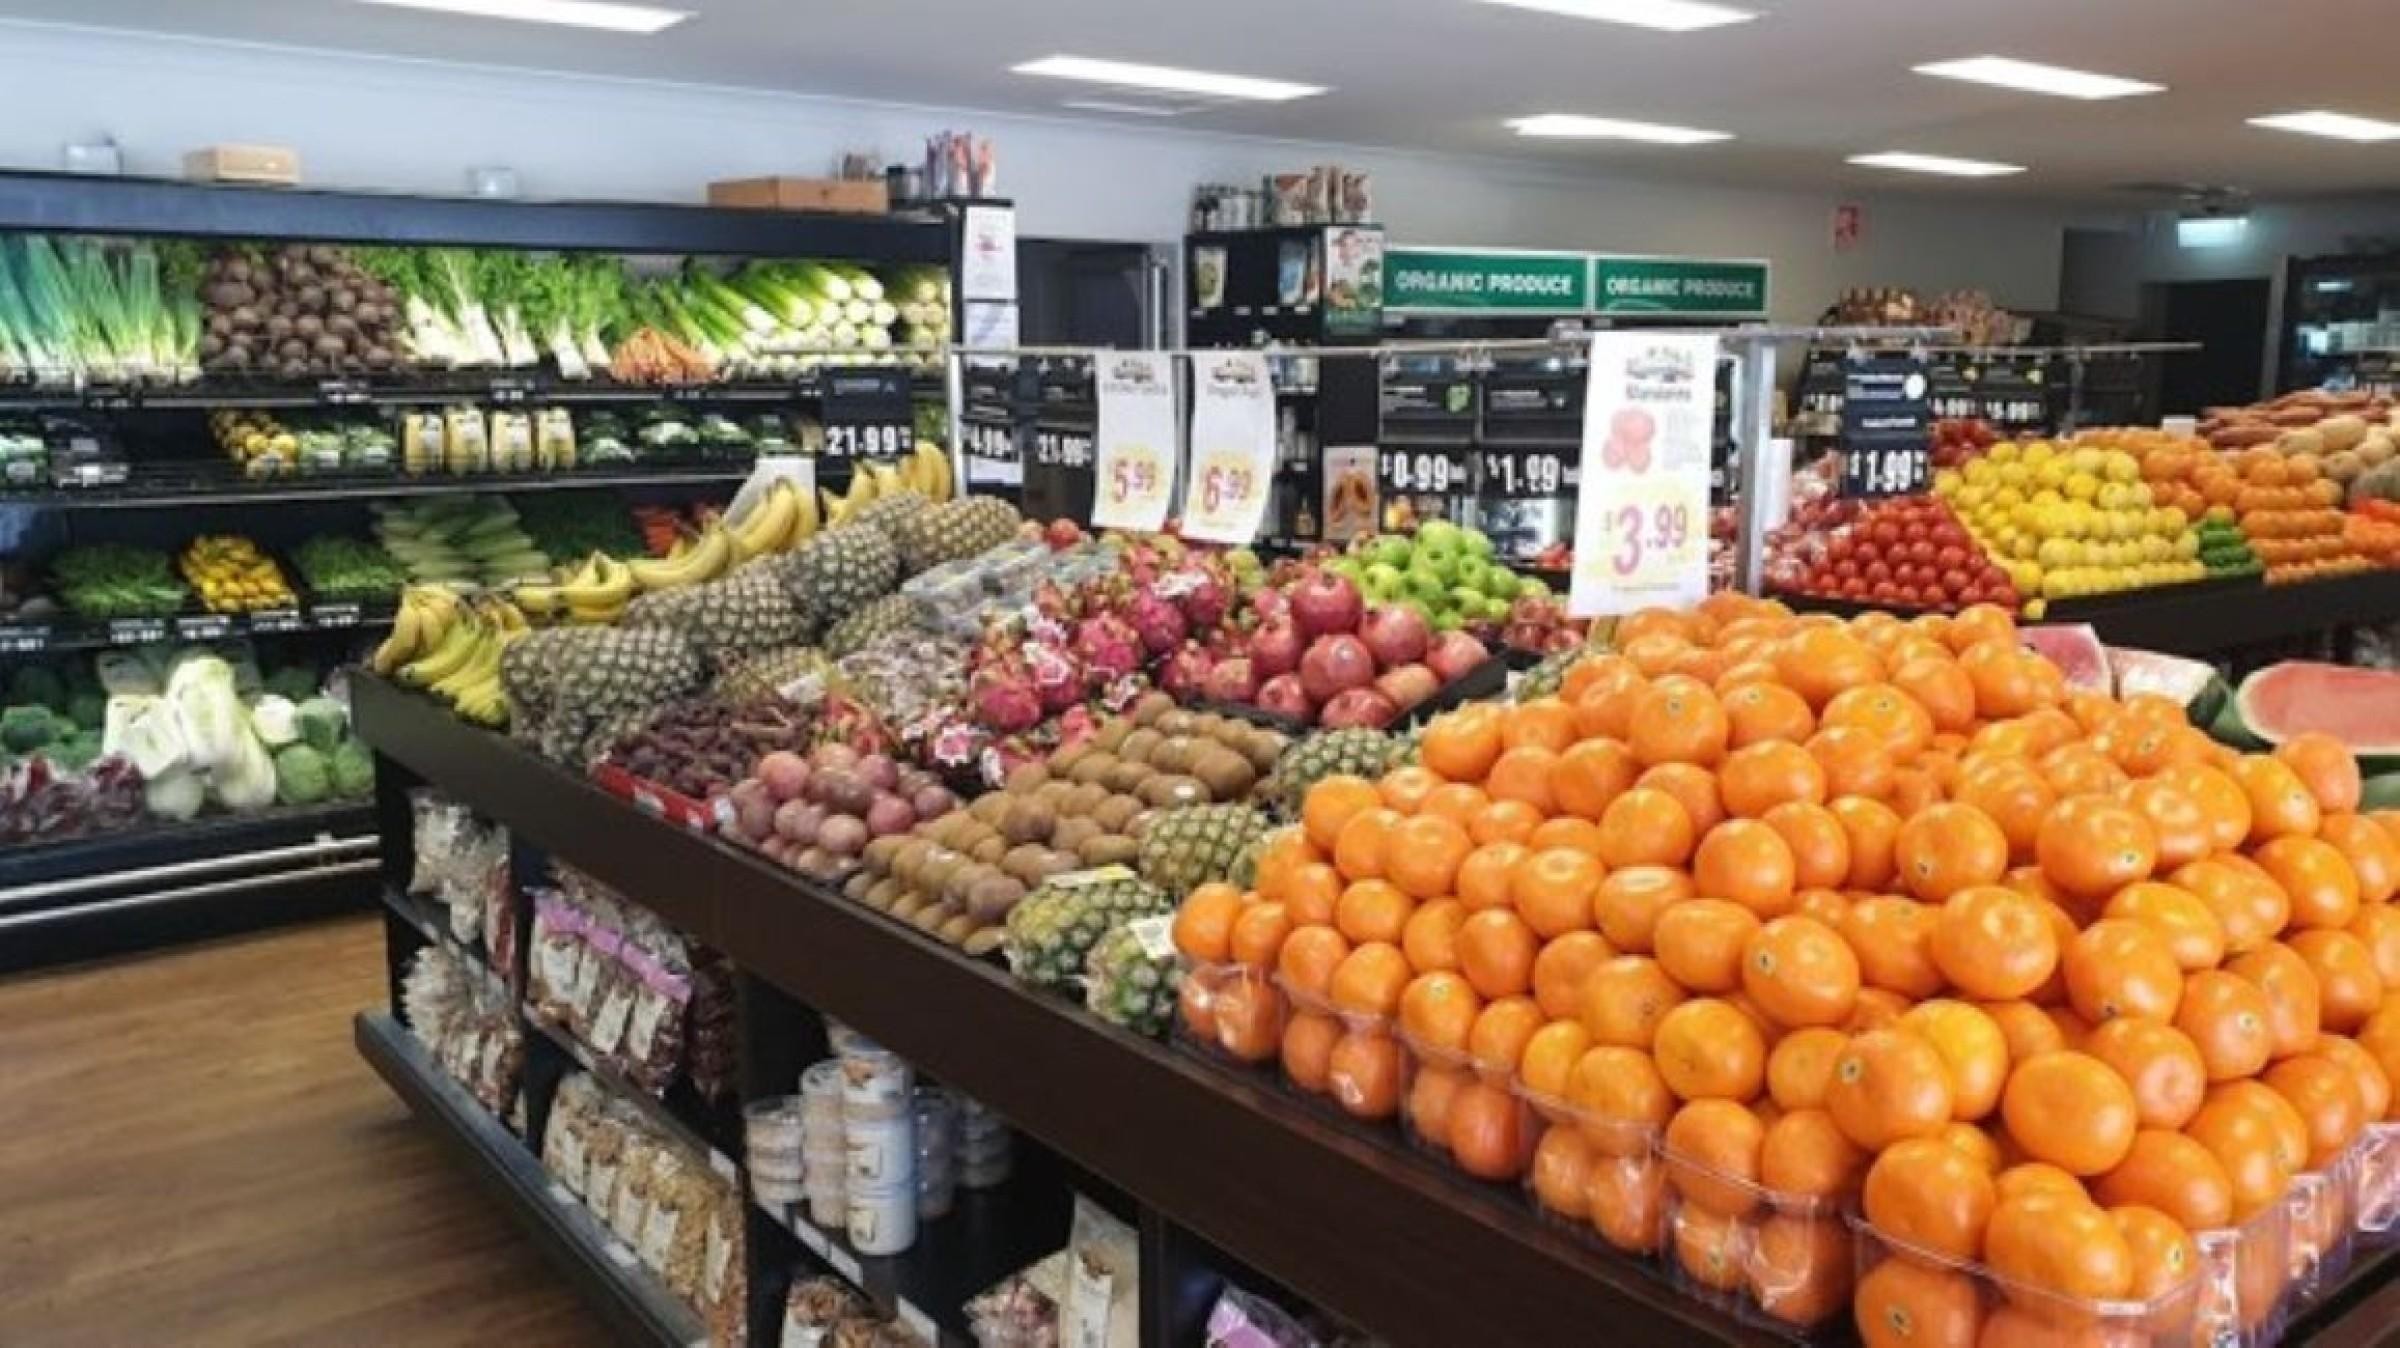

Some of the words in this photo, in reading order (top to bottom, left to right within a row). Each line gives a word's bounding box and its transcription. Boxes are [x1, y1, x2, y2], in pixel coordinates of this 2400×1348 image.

[1394, 269, 1482, 292] ORGANIC
[1487, 272, 1572, 296] PRODUCE
[1605, 277, 1678, 296] ORGANIC
[1683, 279, 1754, 299] PRODUCE
[826, 426, 897, 456] 21.99
[1486, 453, 1560, 494] $1.99
[1850, 450, 1912, 493] $1.99
[1603, 503, 1689, 575] $3.99
